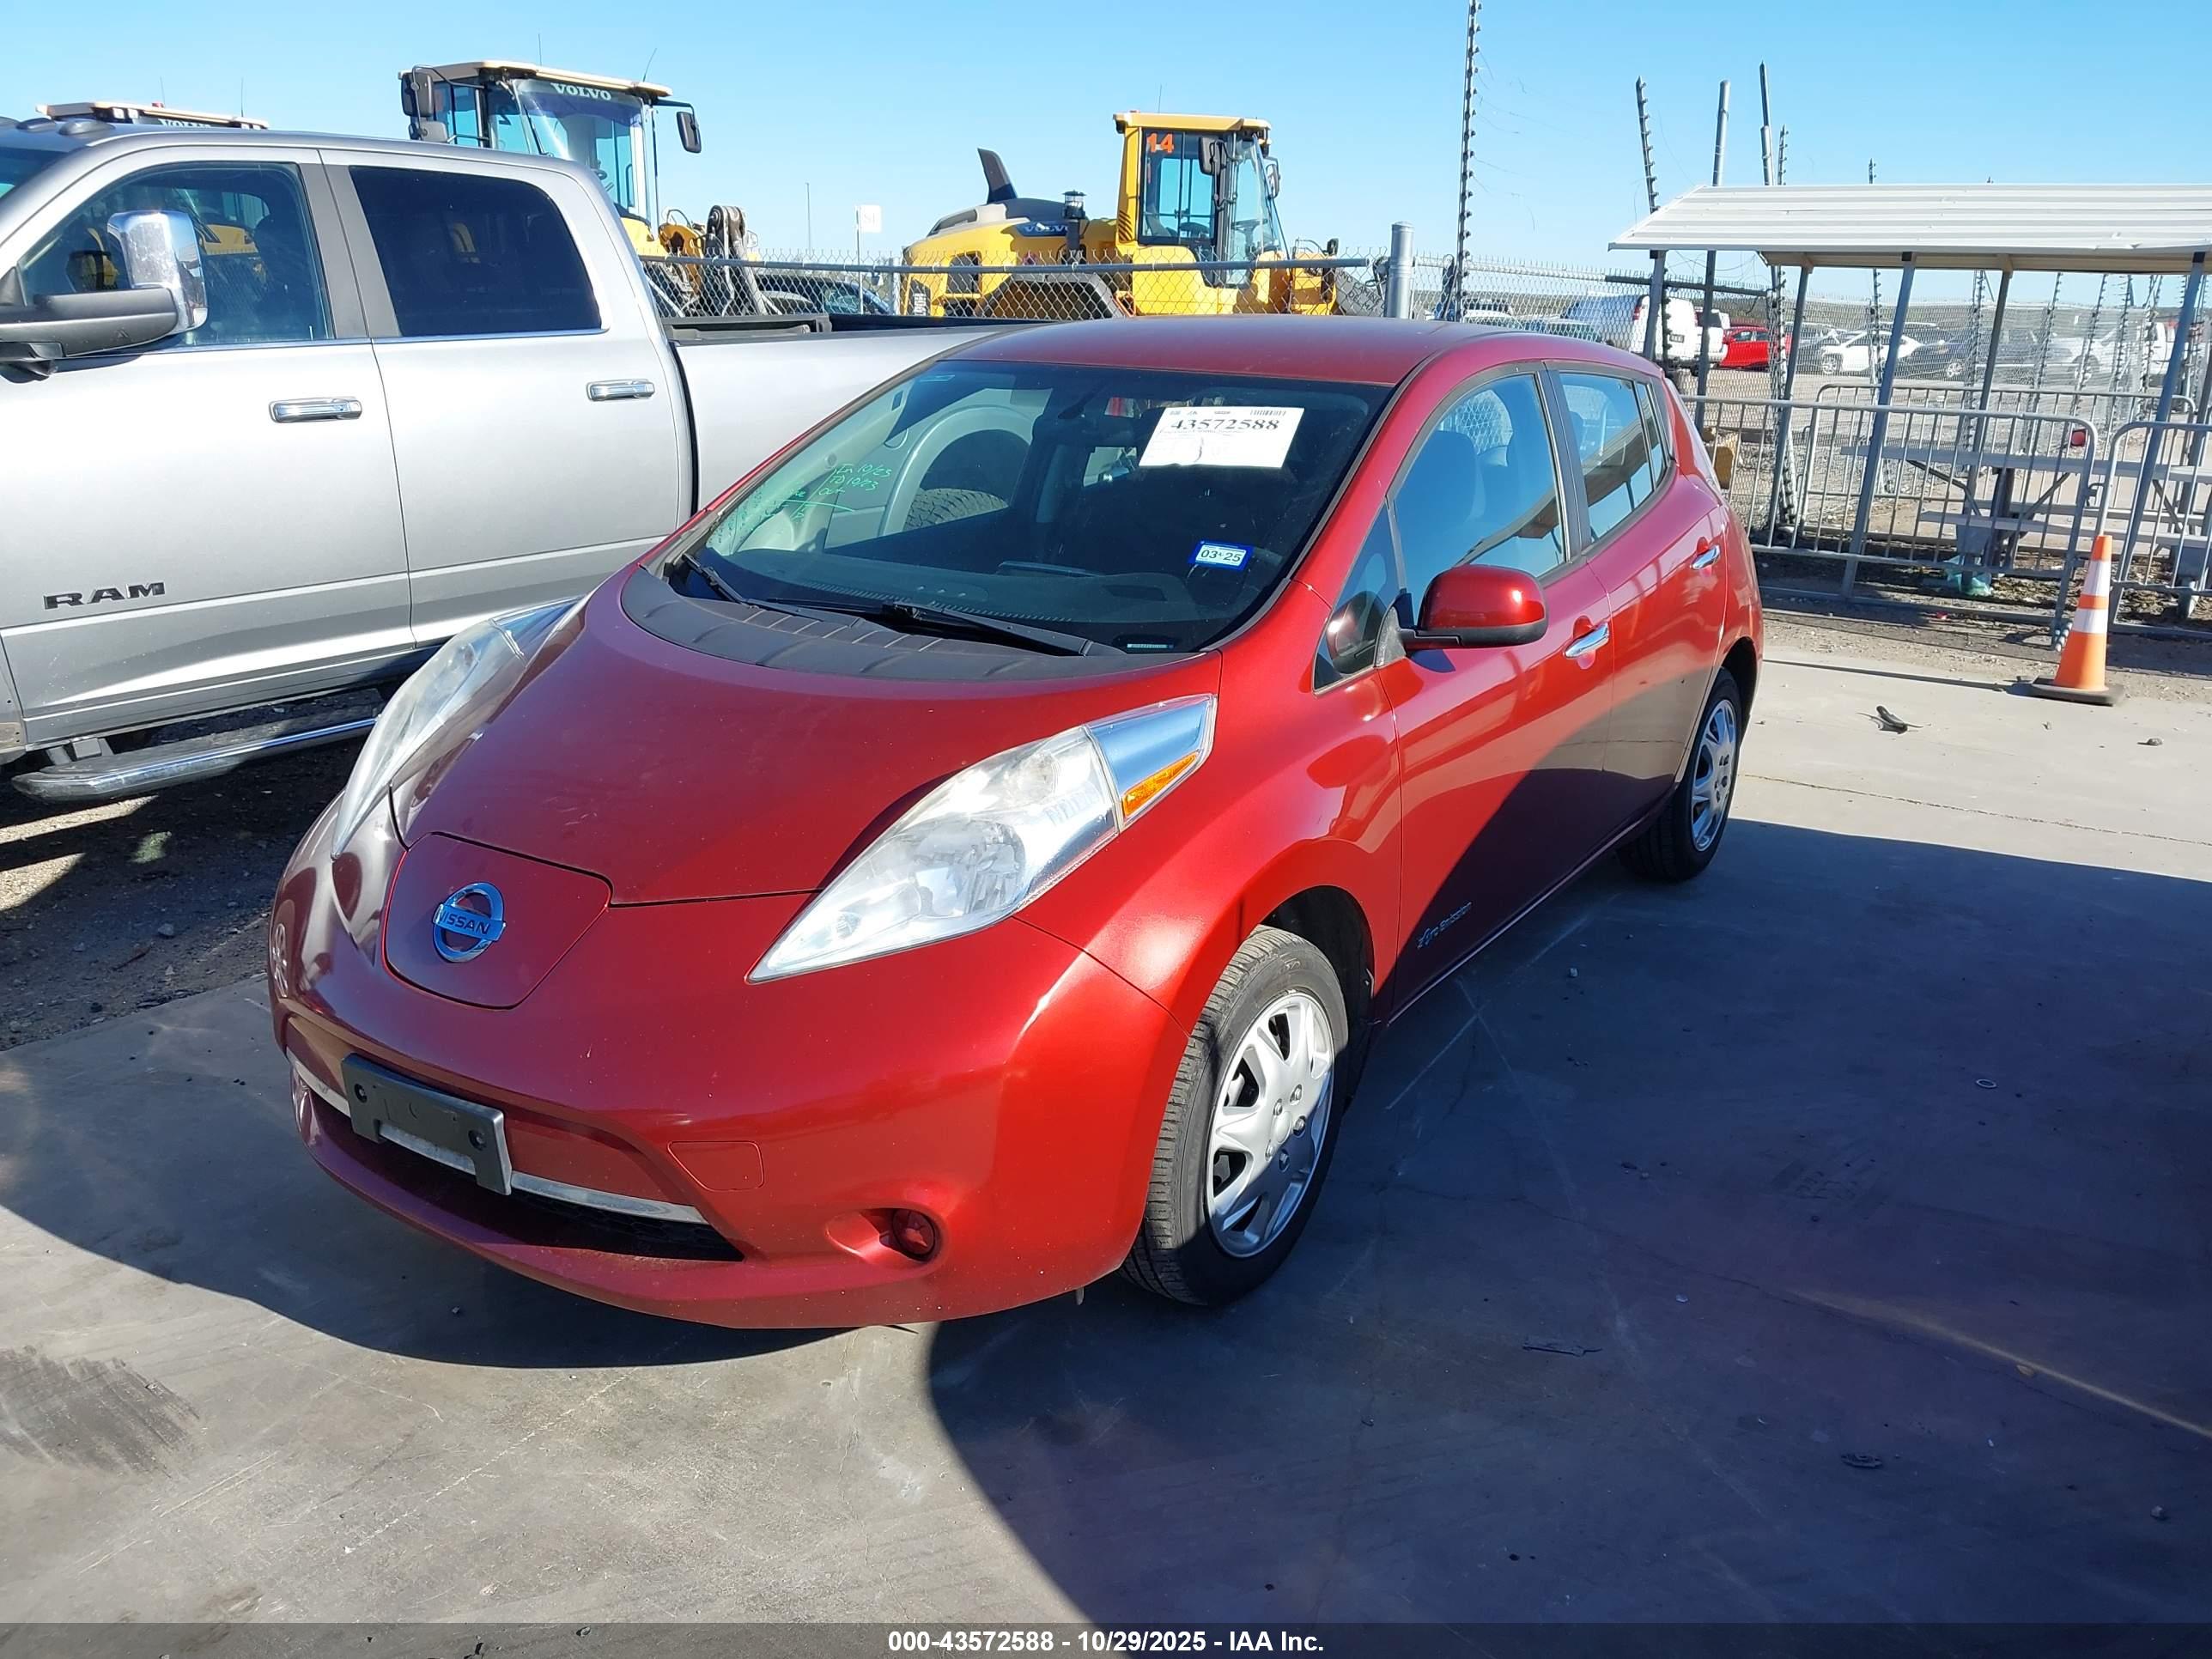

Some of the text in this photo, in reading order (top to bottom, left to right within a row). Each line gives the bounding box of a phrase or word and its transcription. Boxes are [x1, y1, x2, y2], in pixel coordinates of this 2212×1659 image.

[550, 82, 611, 100] VOLVO
[1146, 133, 1174, 153] 14
[1024, 223, 1068, 233] VOLV
[1170, 419, 1280, 430] 43572588
[1200, 550, 1242, 562] 03 25
[43, 582, 166, 610] RAM
[437, 909, 491, 935] NISSAN
